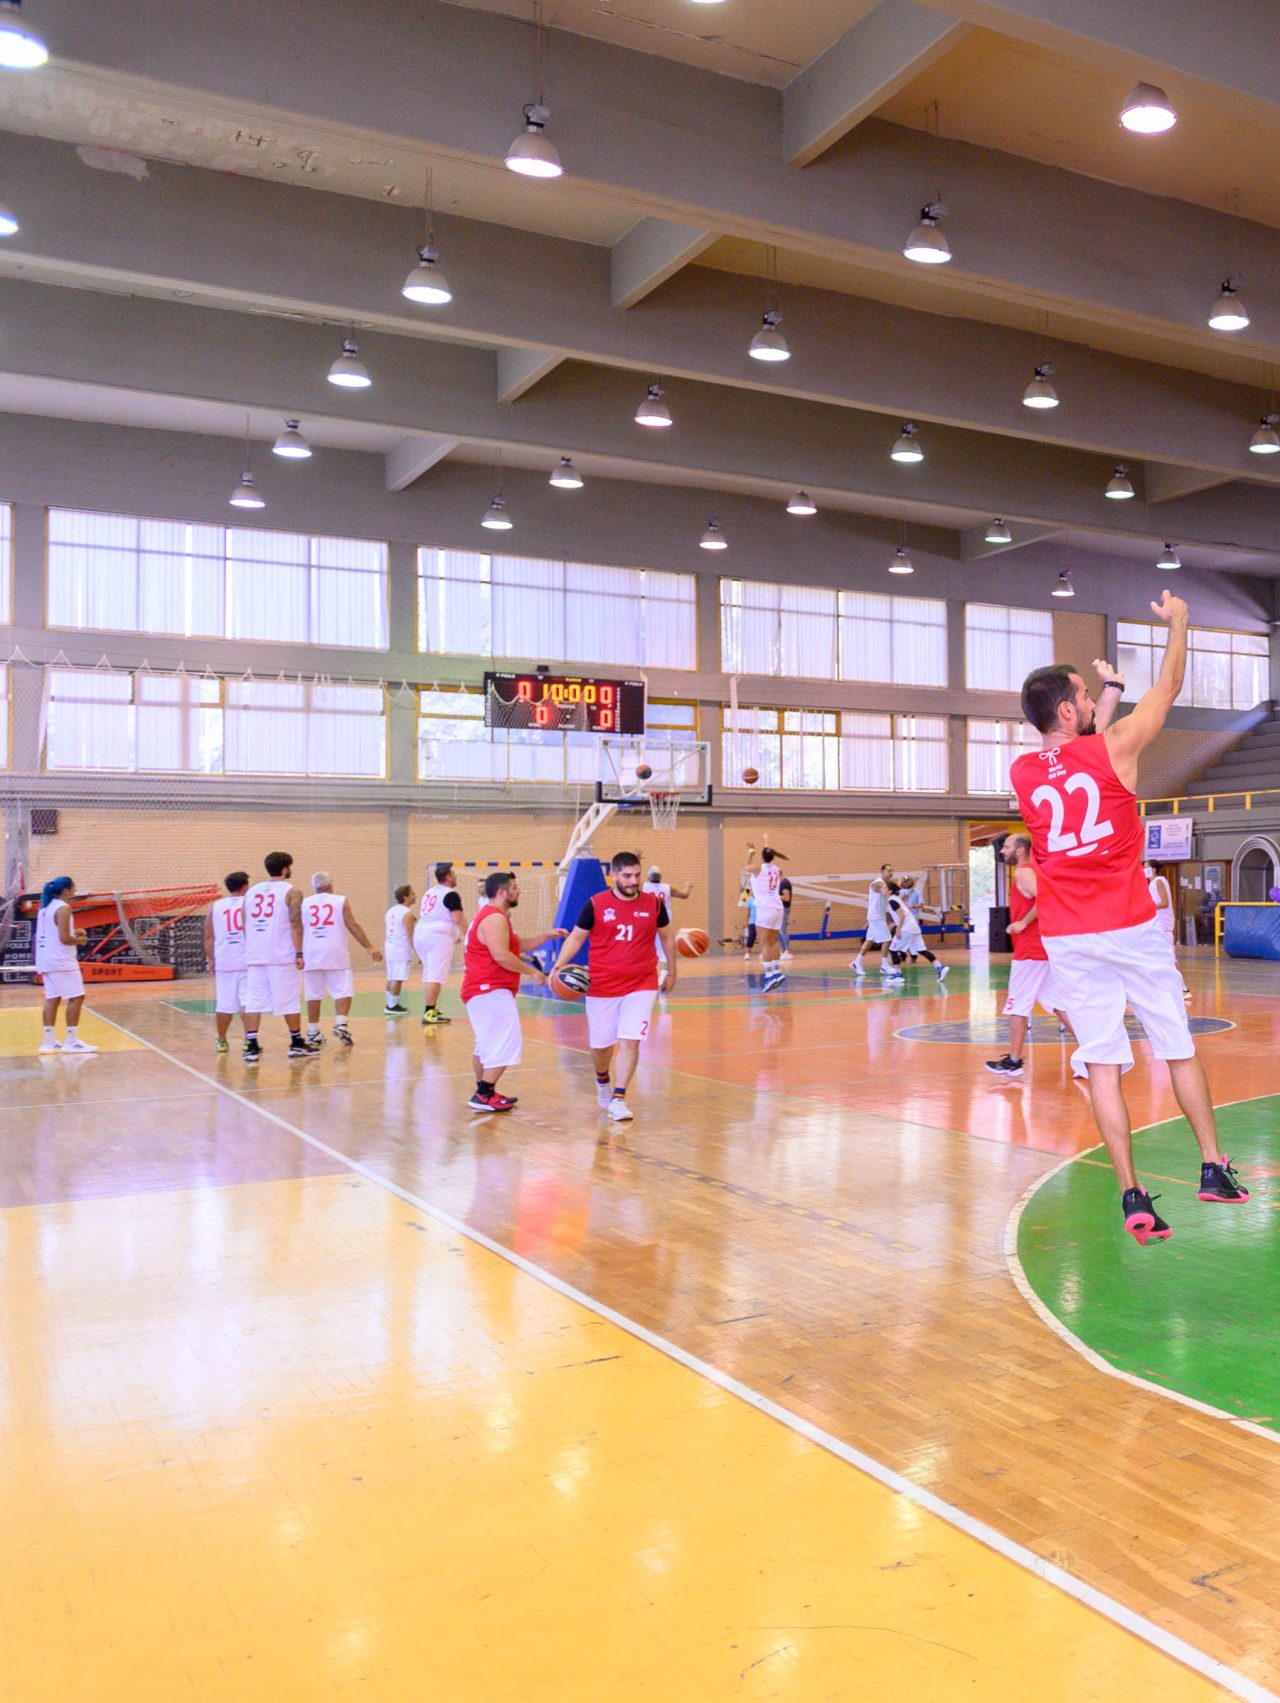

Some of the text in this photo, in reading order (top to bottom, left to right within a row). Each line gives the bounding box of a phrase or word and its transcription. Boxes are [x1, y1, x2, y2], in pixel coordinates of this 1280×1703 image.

[518, 681, 531, 700] 0
[543, 683, 597, 704] 10:00
[600, 686, 613, 705] 0
[536, 706, 548, 724] 0
[600, 709, 613, 728] 0
[1031, 772, 1115, 853] 22
[252, 893, 276, 918] 33
[421, 894, 438, 912] 39
[223, 908, 245, 932] 10
[309, 904, 334, 927] 32
[615, 924, 634, 942] 21
[92, 967, 123, 976] SPORT
